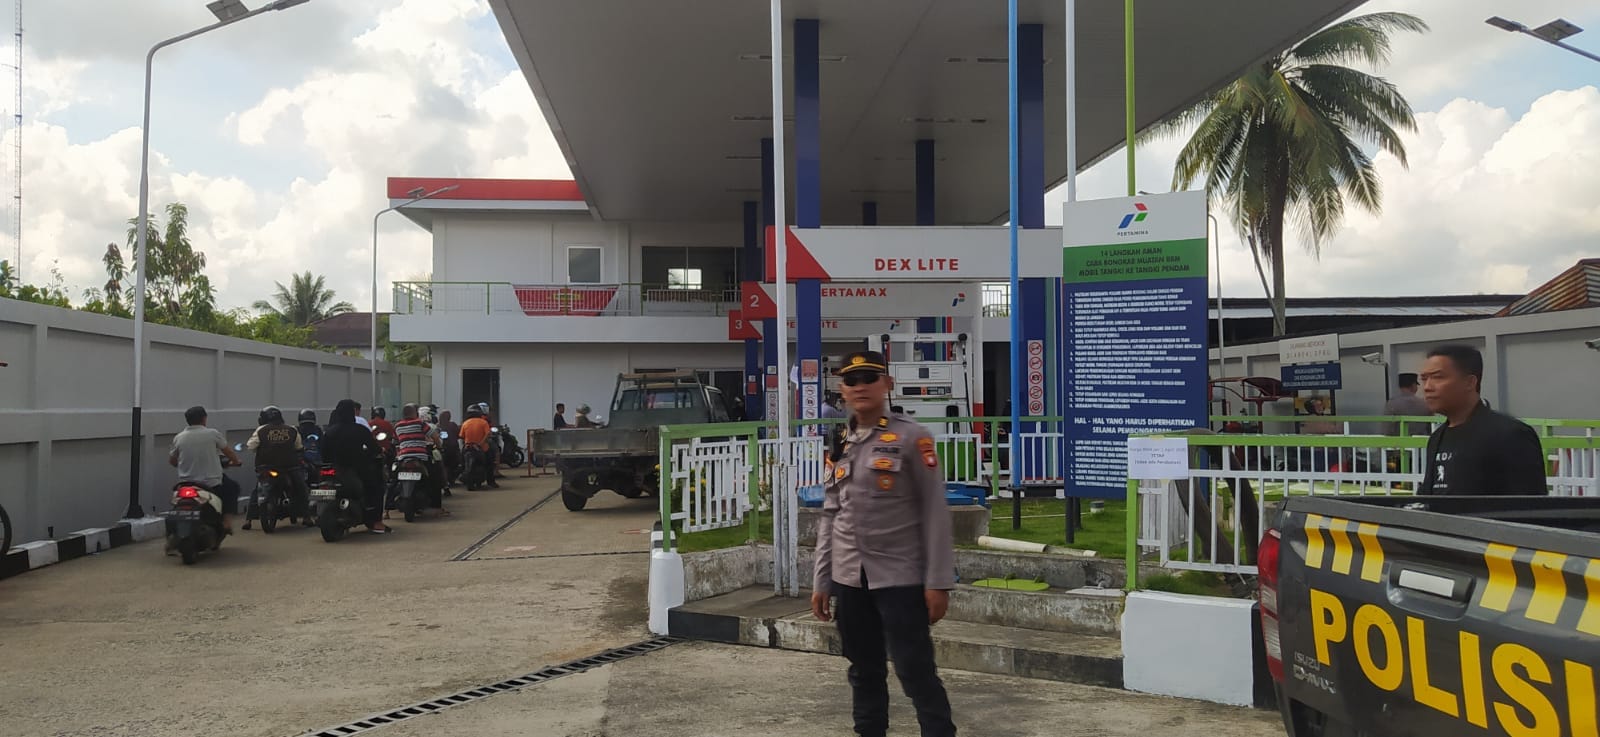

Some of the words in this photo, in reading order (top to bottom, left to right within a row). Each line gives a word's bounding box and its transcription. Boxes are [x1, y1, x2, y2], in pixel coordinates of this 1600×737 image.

[874, 258, 911, 271] DEX
[918, 258, 959, 271] LITE
[821, 287, 887, 297] ERTAMAX
[750, 294, 760, 308] 2
[735, 319, 743, 330] 3
[1074, 417, 1087, 425] HAL
[1092, 417, 1105, 425] HAL
[1106, 417, 1124, 425] YANG
[1147, 418, 1195, 427] DIPERHATIKAN
[1294, 650, 1321, 671] ISUZU
[1310, 588, 1600, 737] POLISI
